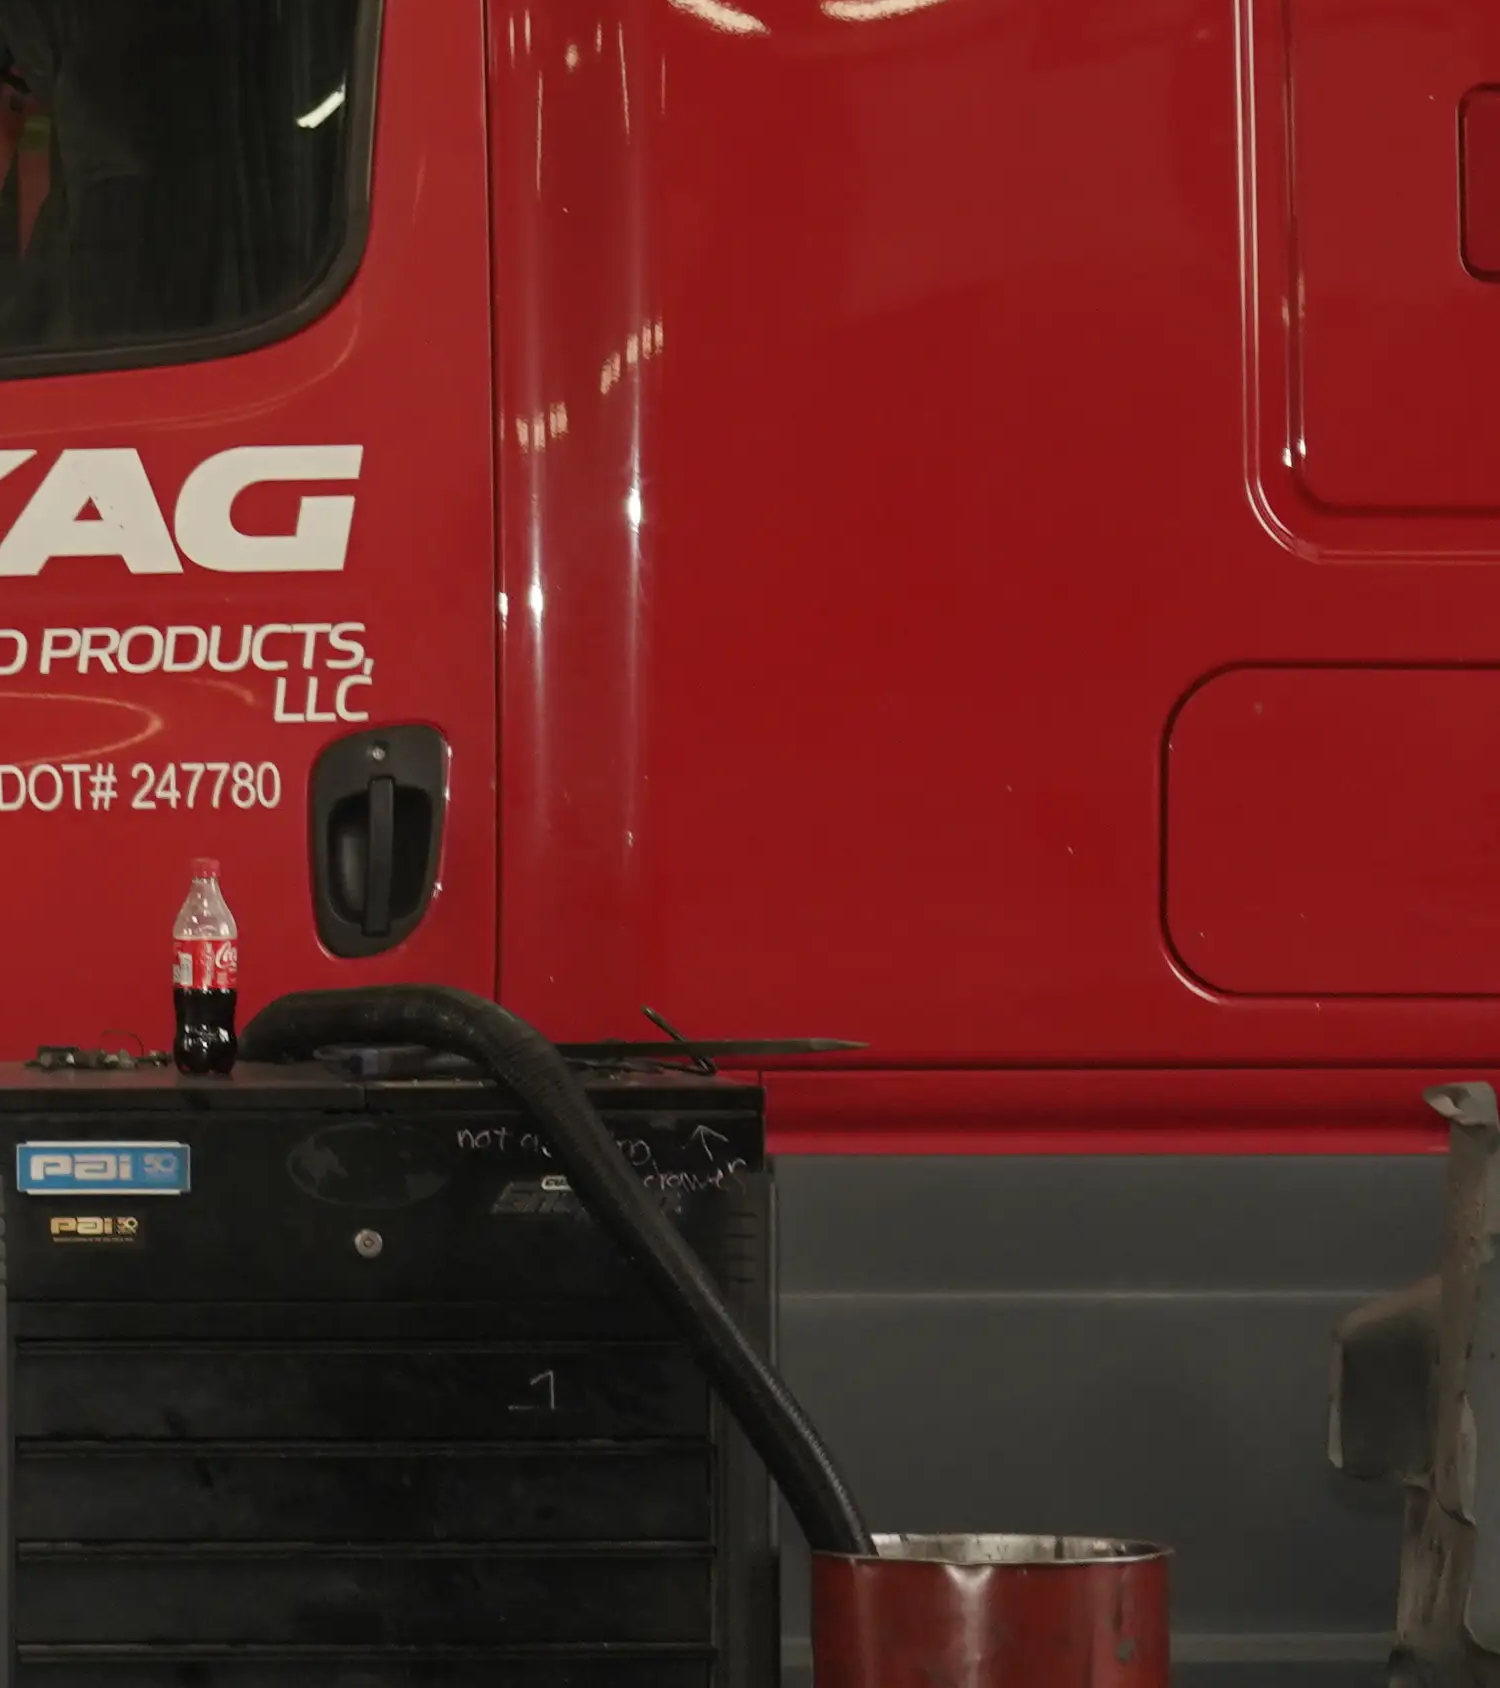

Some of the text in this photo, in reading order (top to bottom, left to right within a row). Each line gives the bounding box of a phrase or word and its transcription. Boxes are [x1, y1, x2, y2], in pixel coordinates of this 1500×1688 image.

[39, 622, 374, 675] PRODUCTS,
[273, 675, 372, 723] LLC
[131, 762, 281, 810] 247780
